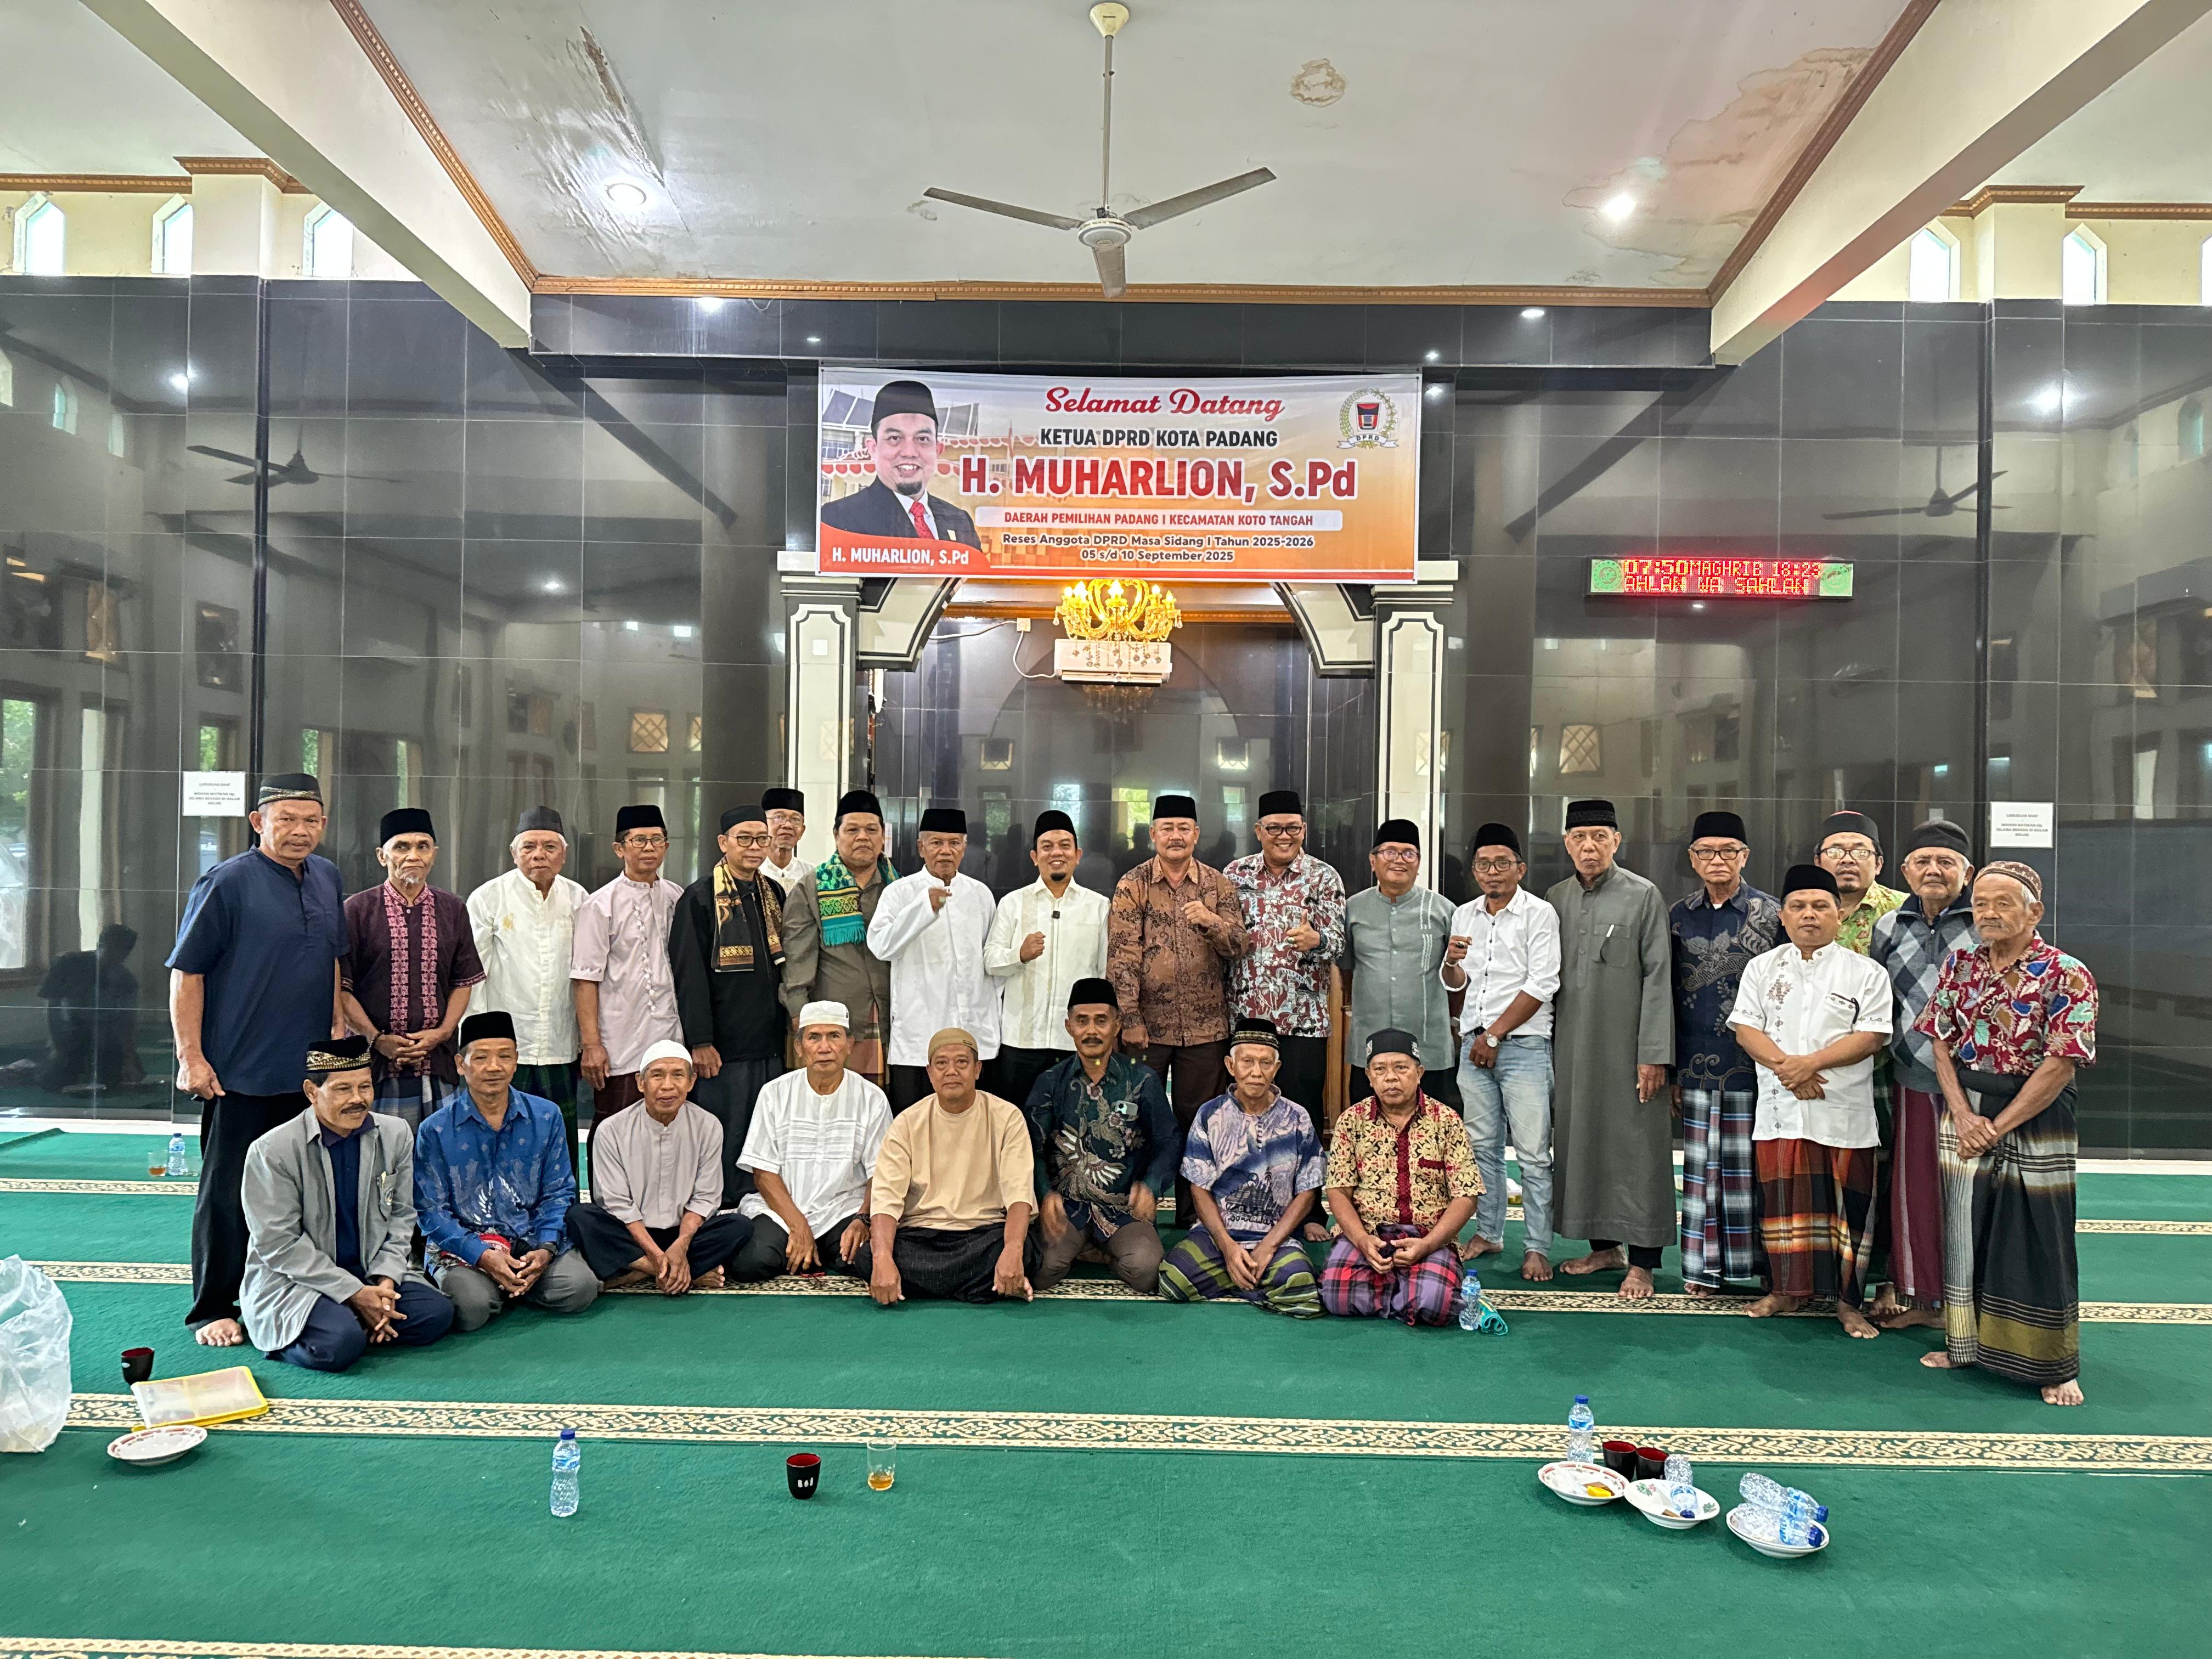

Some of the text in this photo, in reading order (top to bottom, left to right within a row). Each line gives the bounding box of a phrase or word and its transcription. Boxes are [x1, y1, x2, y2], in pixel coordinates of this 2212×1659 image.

[1046, 386, 1285, 421] Selamat Datang
[1041, 428, 1278, 447] KETUA DPRD KOTA PADANG
[962, 458, 1356, 503] H. MUHARLION, S.Pd
[1005, 512, 1048, 523] DAERAH
[1052, 513, 1111, 524] PEMILIHAN
[1114, 514, 1159, 524] PADANG
[1170, 515, 1234, 525] KECAMATAN
[1238, 515, 1266, 525] KOTO
[1269, 515, 1313, 525] TANGAH
[1003, 534, 1036, 544] Reses
[1040, 535, 1090, 546] Anggota
[1094, 535, 1127, 545] DPRD
[1132, 536, 1160, 545] Masa
[1164, 536, 1203, 548] Sidang
[1215, 537, 1249, 546] Tahun
[1253, 537, 1313, 546] 2025-2026
[832, 547, 969, 566] H. MUHARLION, S.Pd
[1082, 549, 1233, 561] 05 s/d 10 September 2025
[1624, 559, 1822, 579] 07:50 MAGHRIB 18:23
[1624, 575, 1808, 595] AHLAN WA SAHLAN
